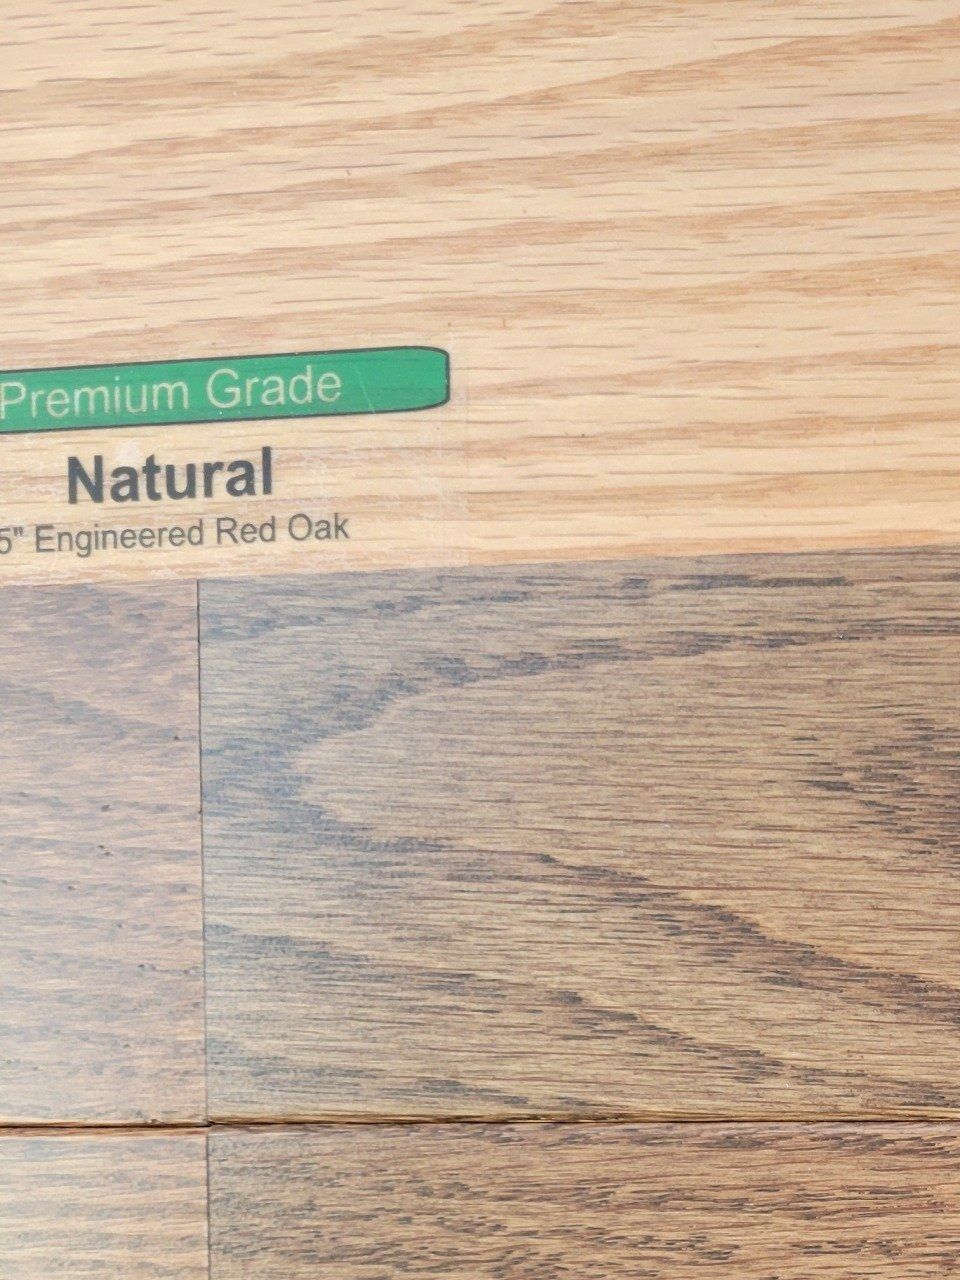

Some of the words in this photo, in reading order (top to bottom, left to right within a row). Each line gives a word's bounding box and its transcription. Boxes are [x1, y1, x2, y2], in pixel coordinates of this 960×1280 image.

[0, 375, 189, 420] Premium
[206, 365, 342, 409] Grade
[67, 446, 273, 504] Natural
[35, 519, 204, 558] Engineered
[216, 515, 276, 545] Red
[288, 512, 350, 541] Oak
